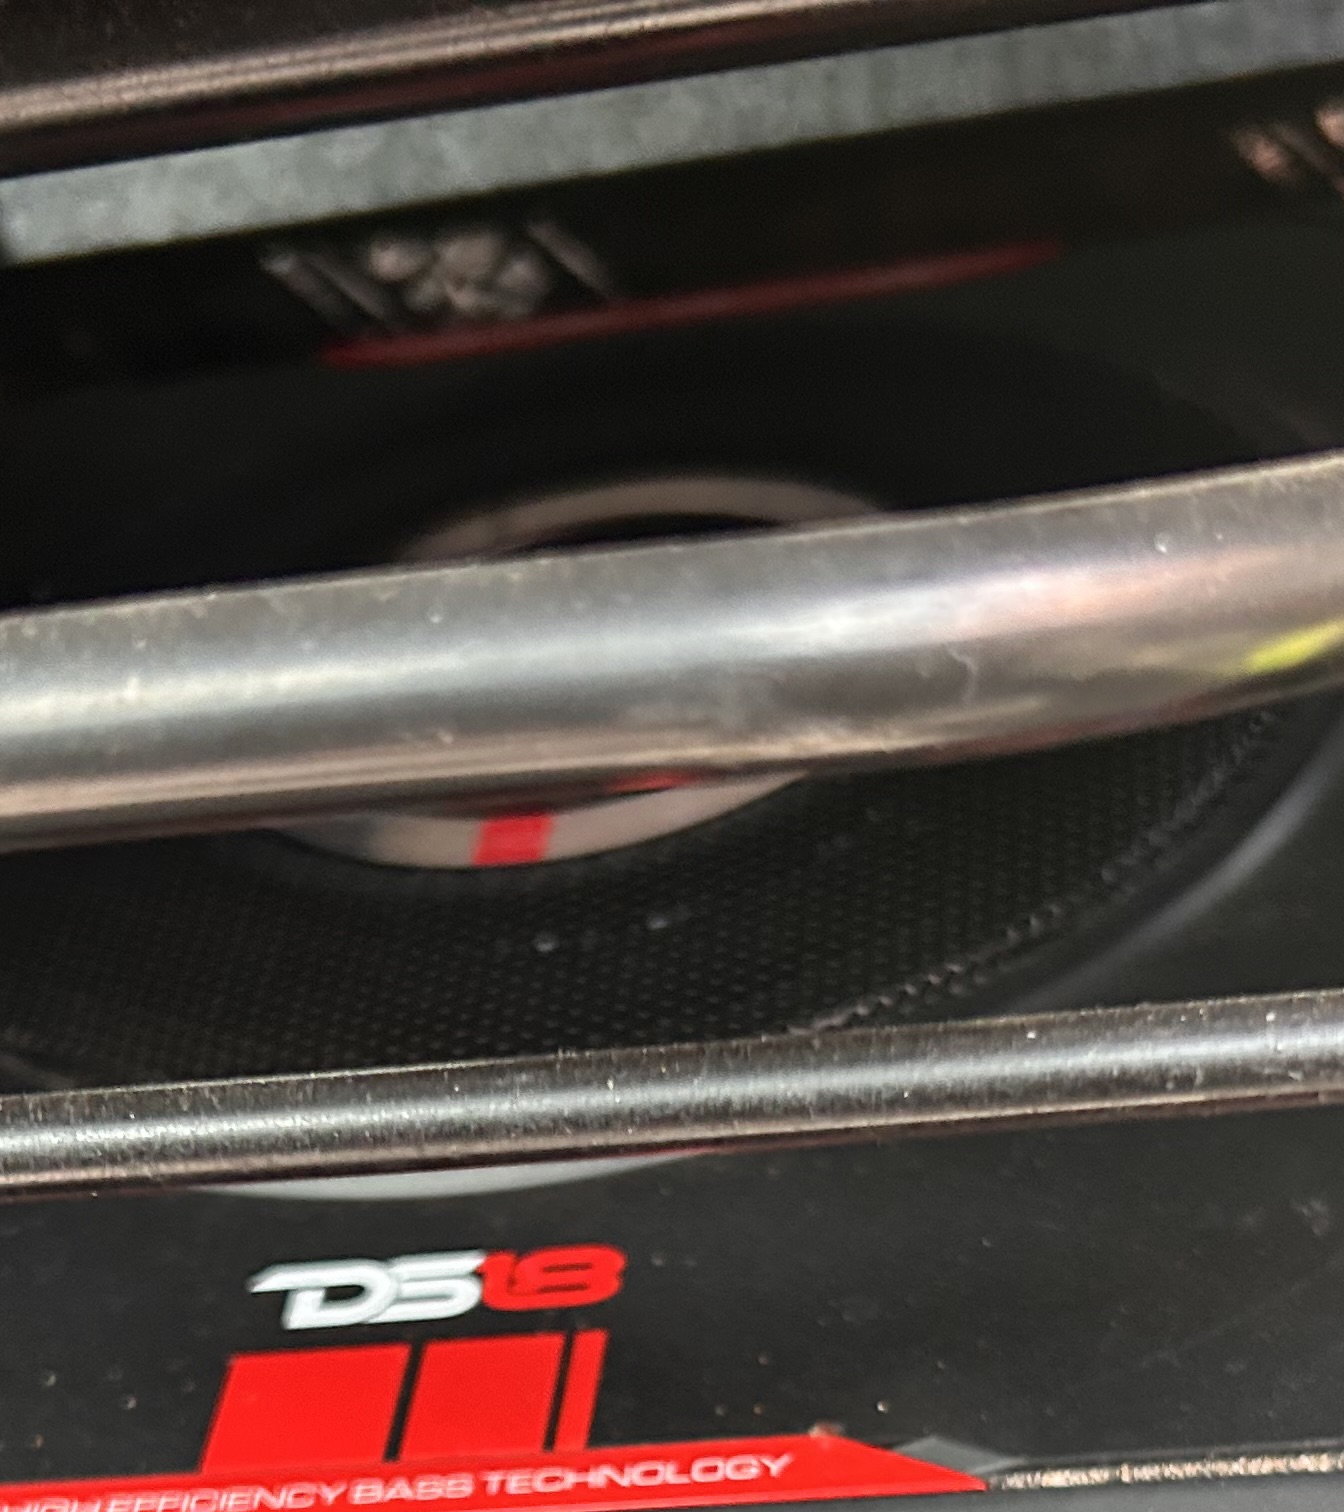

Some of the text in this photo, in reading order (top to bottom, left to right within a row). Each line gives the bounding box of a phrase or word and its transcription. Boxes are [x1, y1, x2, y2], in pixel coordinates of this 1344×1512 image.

[247, 1245, 625, 1330] DS18
[350, 1474, 474, 1506] BASS
[481, 1452, 794, 1497] TECHNOLOGY
